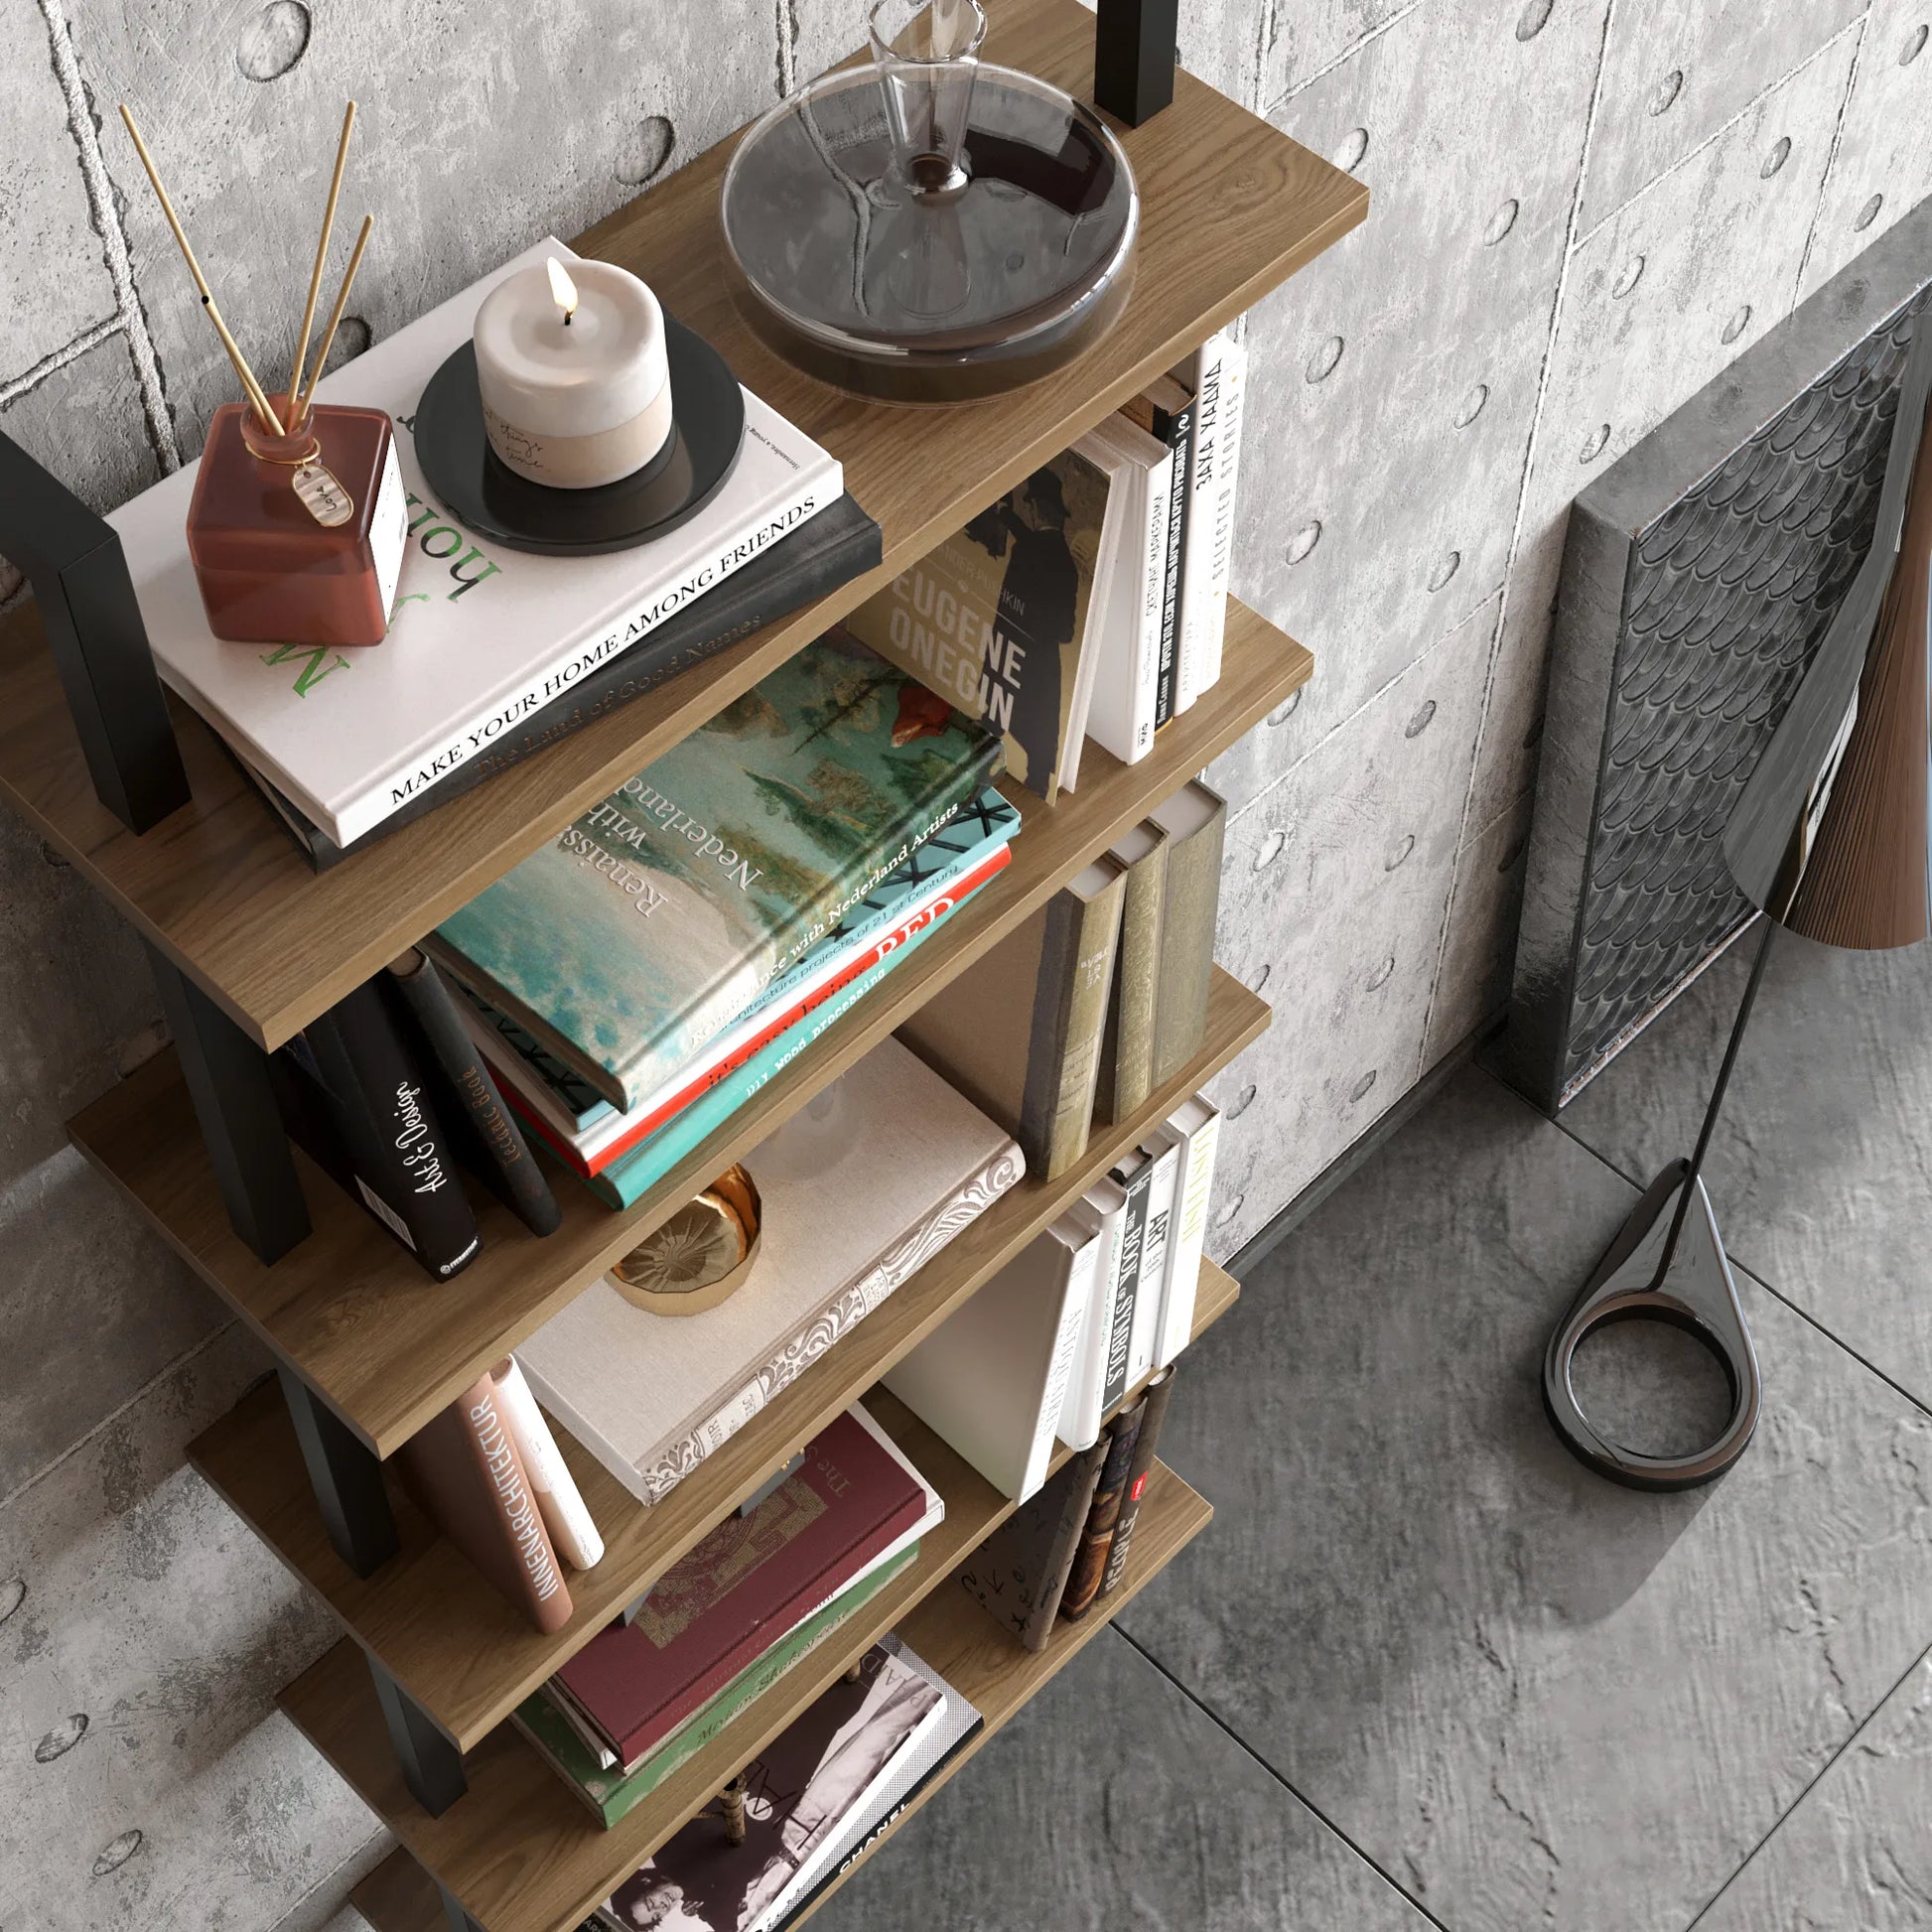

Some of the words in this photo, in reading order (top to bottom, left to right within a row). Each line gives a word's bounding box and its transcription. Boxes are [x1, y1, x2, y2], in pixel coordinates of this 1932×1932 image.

[1200, 357, 1222, 435] ХАДИД
[1196, 436, 1215, 490] ЗАХА
[1220, 392, 1239, 480] STORIES
[317, 485, 337, 511] Love
[390, 745, 464, 805] MAKE
[468, 694, 539, 749] YOUR
[544, 634, 619, 698] HOME
[624, 569, 714, 640] AMONG
[720, 496, 815, 573] FRIENDS
[687, 614, 762, 658] Names
[893, 566, 1026, 689] EUGENE
[890, 607, 1015, 732] ONEGIN
[588, 800, 646, 849] with
[563, 825, 667, 917] Renaiss
[790, 922, 825, 957] with
[828, 846, 908, 926] Nederland
[911, 802, 959, 852] Artists
[800, 937, 855, 978] projects
[857, 925, 870, 941] of
[908, 864, 959, 902] Century
[774, 1036, 807, 1071] wood
[811, 968, 886, 1039] processing
[394, 1081, 428, 1149] Design
[459, 1065, 490, 1109] Book
[403, 1142, 435, 1166] &
[483, 1107, 523, 1168] Technic
[414, 1158, 448, 1193] Art
[1120, 1223, 1143, 1288] BOOK
[1124, 1209, 1137, 1237] THE
[1146, 1209, 1170, 1252] ART
[1043, 1308, 1083, 1437] ANTIQUAIRES
[1106, 1294, 1134, 1387] SYMBOLS
[470, 1394, 559, 1601] INNENARCHITEKTUR
[838, 1802, 912, 1874] CHANEL
